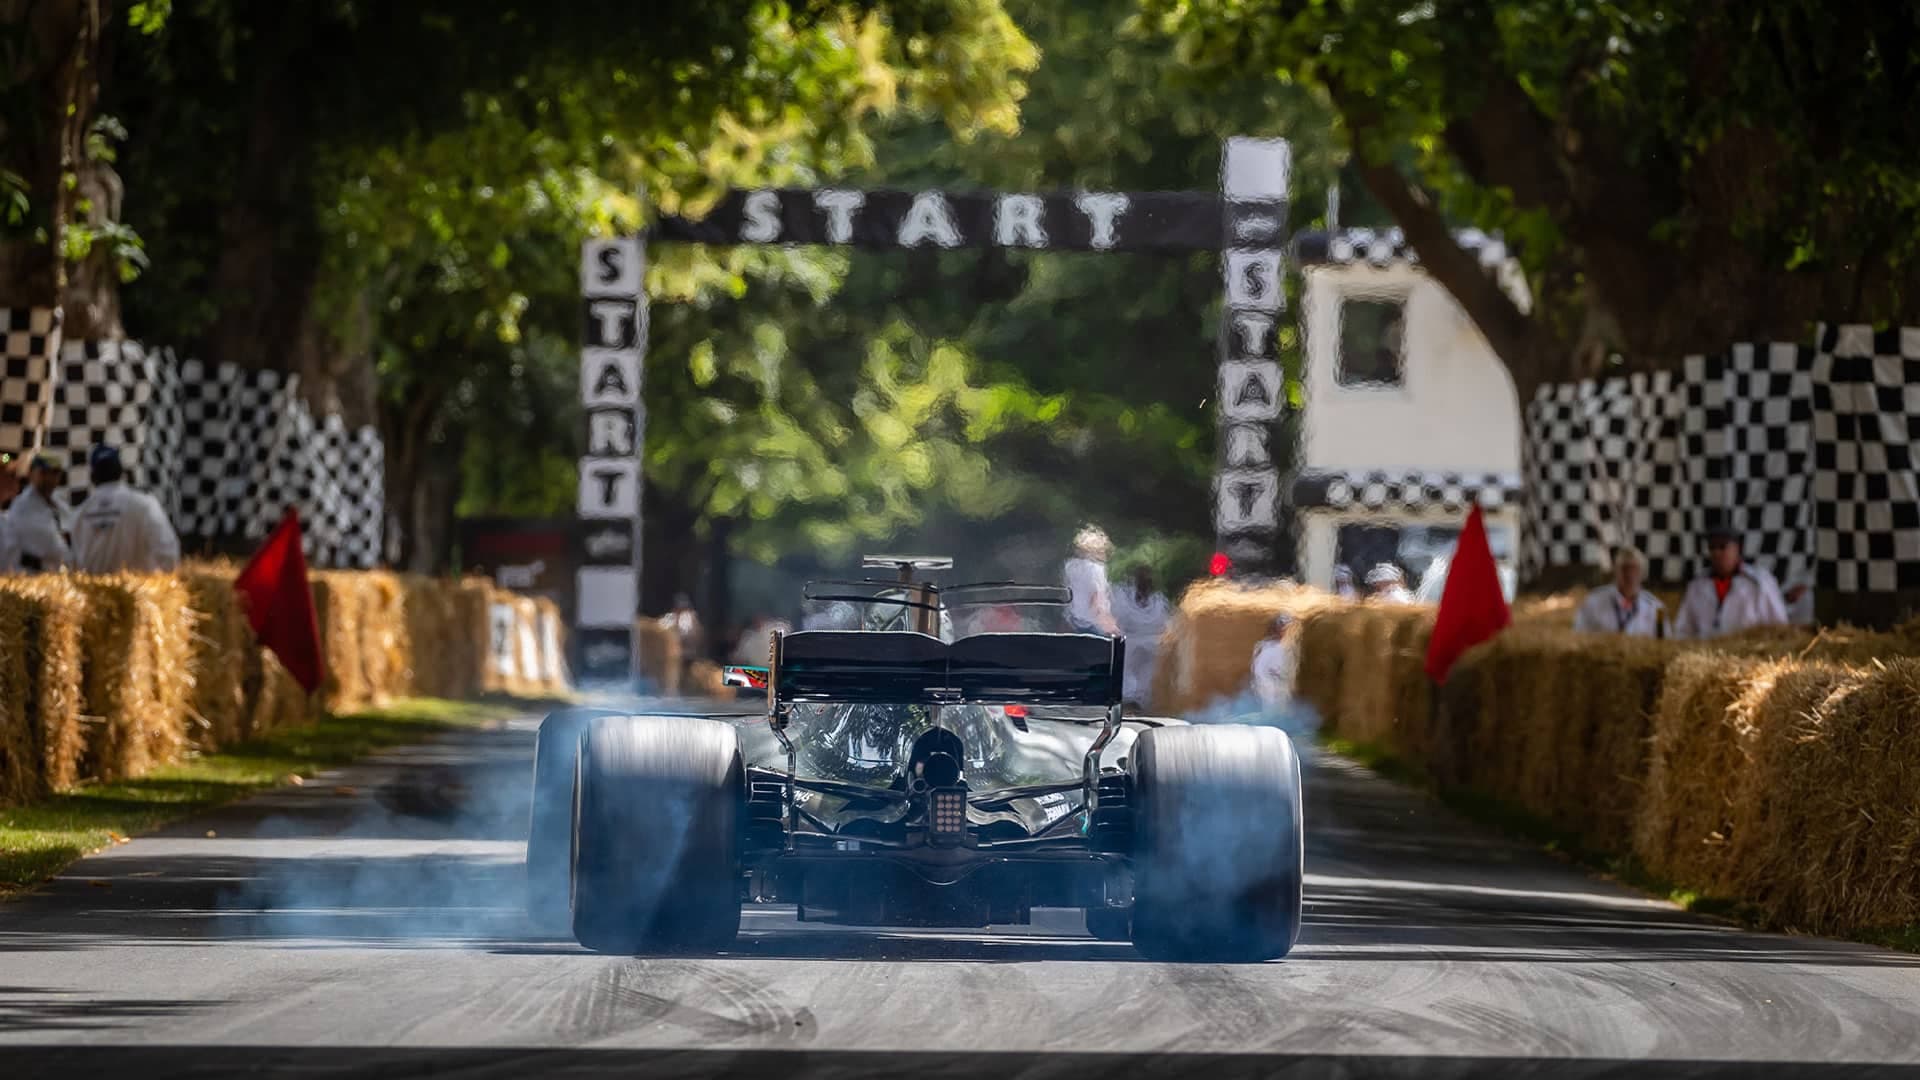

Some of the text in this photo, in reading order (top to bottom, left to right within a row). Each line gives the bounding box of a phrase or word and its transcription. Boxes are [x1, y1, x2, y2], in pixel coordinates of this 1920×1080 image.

[740, 190, 1130, 249] START
[588, 246, 636, 507] START
[1229, 260, 1274, 519] START
